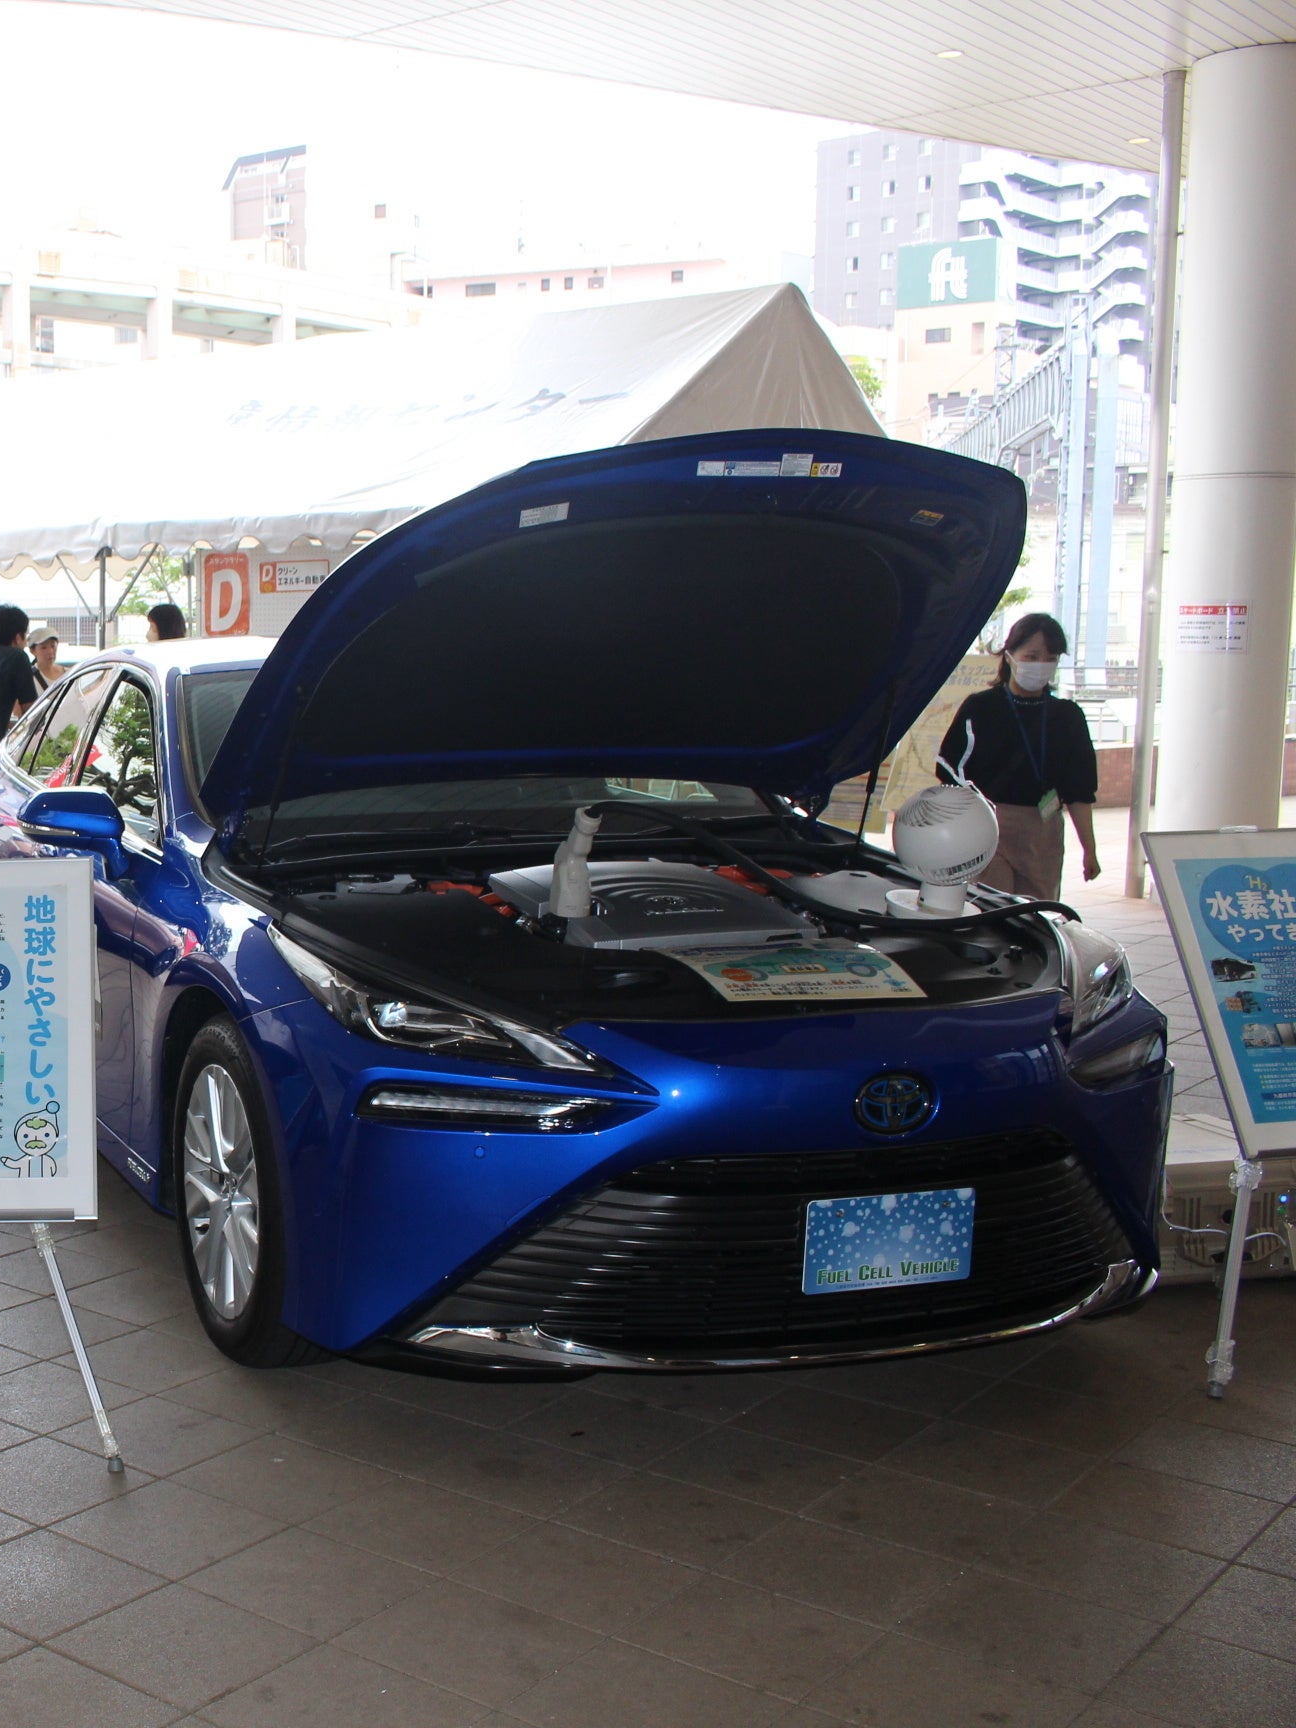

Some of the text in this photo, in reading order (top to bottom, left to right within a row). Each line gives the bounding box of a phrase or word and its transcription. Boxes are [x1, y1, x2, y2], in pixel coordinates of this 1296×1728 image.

[262, 565, 274, 582] D
[211, 568, 243, 632] D
[1205, 889, 1296, 921] 水素社
[24, 894, 56, 1105] 地球にやさしい
[816, 1268, 852, 1285] FUEL
[858, 1264, 893, 1281] CELL
[900, 1257, 960, 1277] VEHICLE
